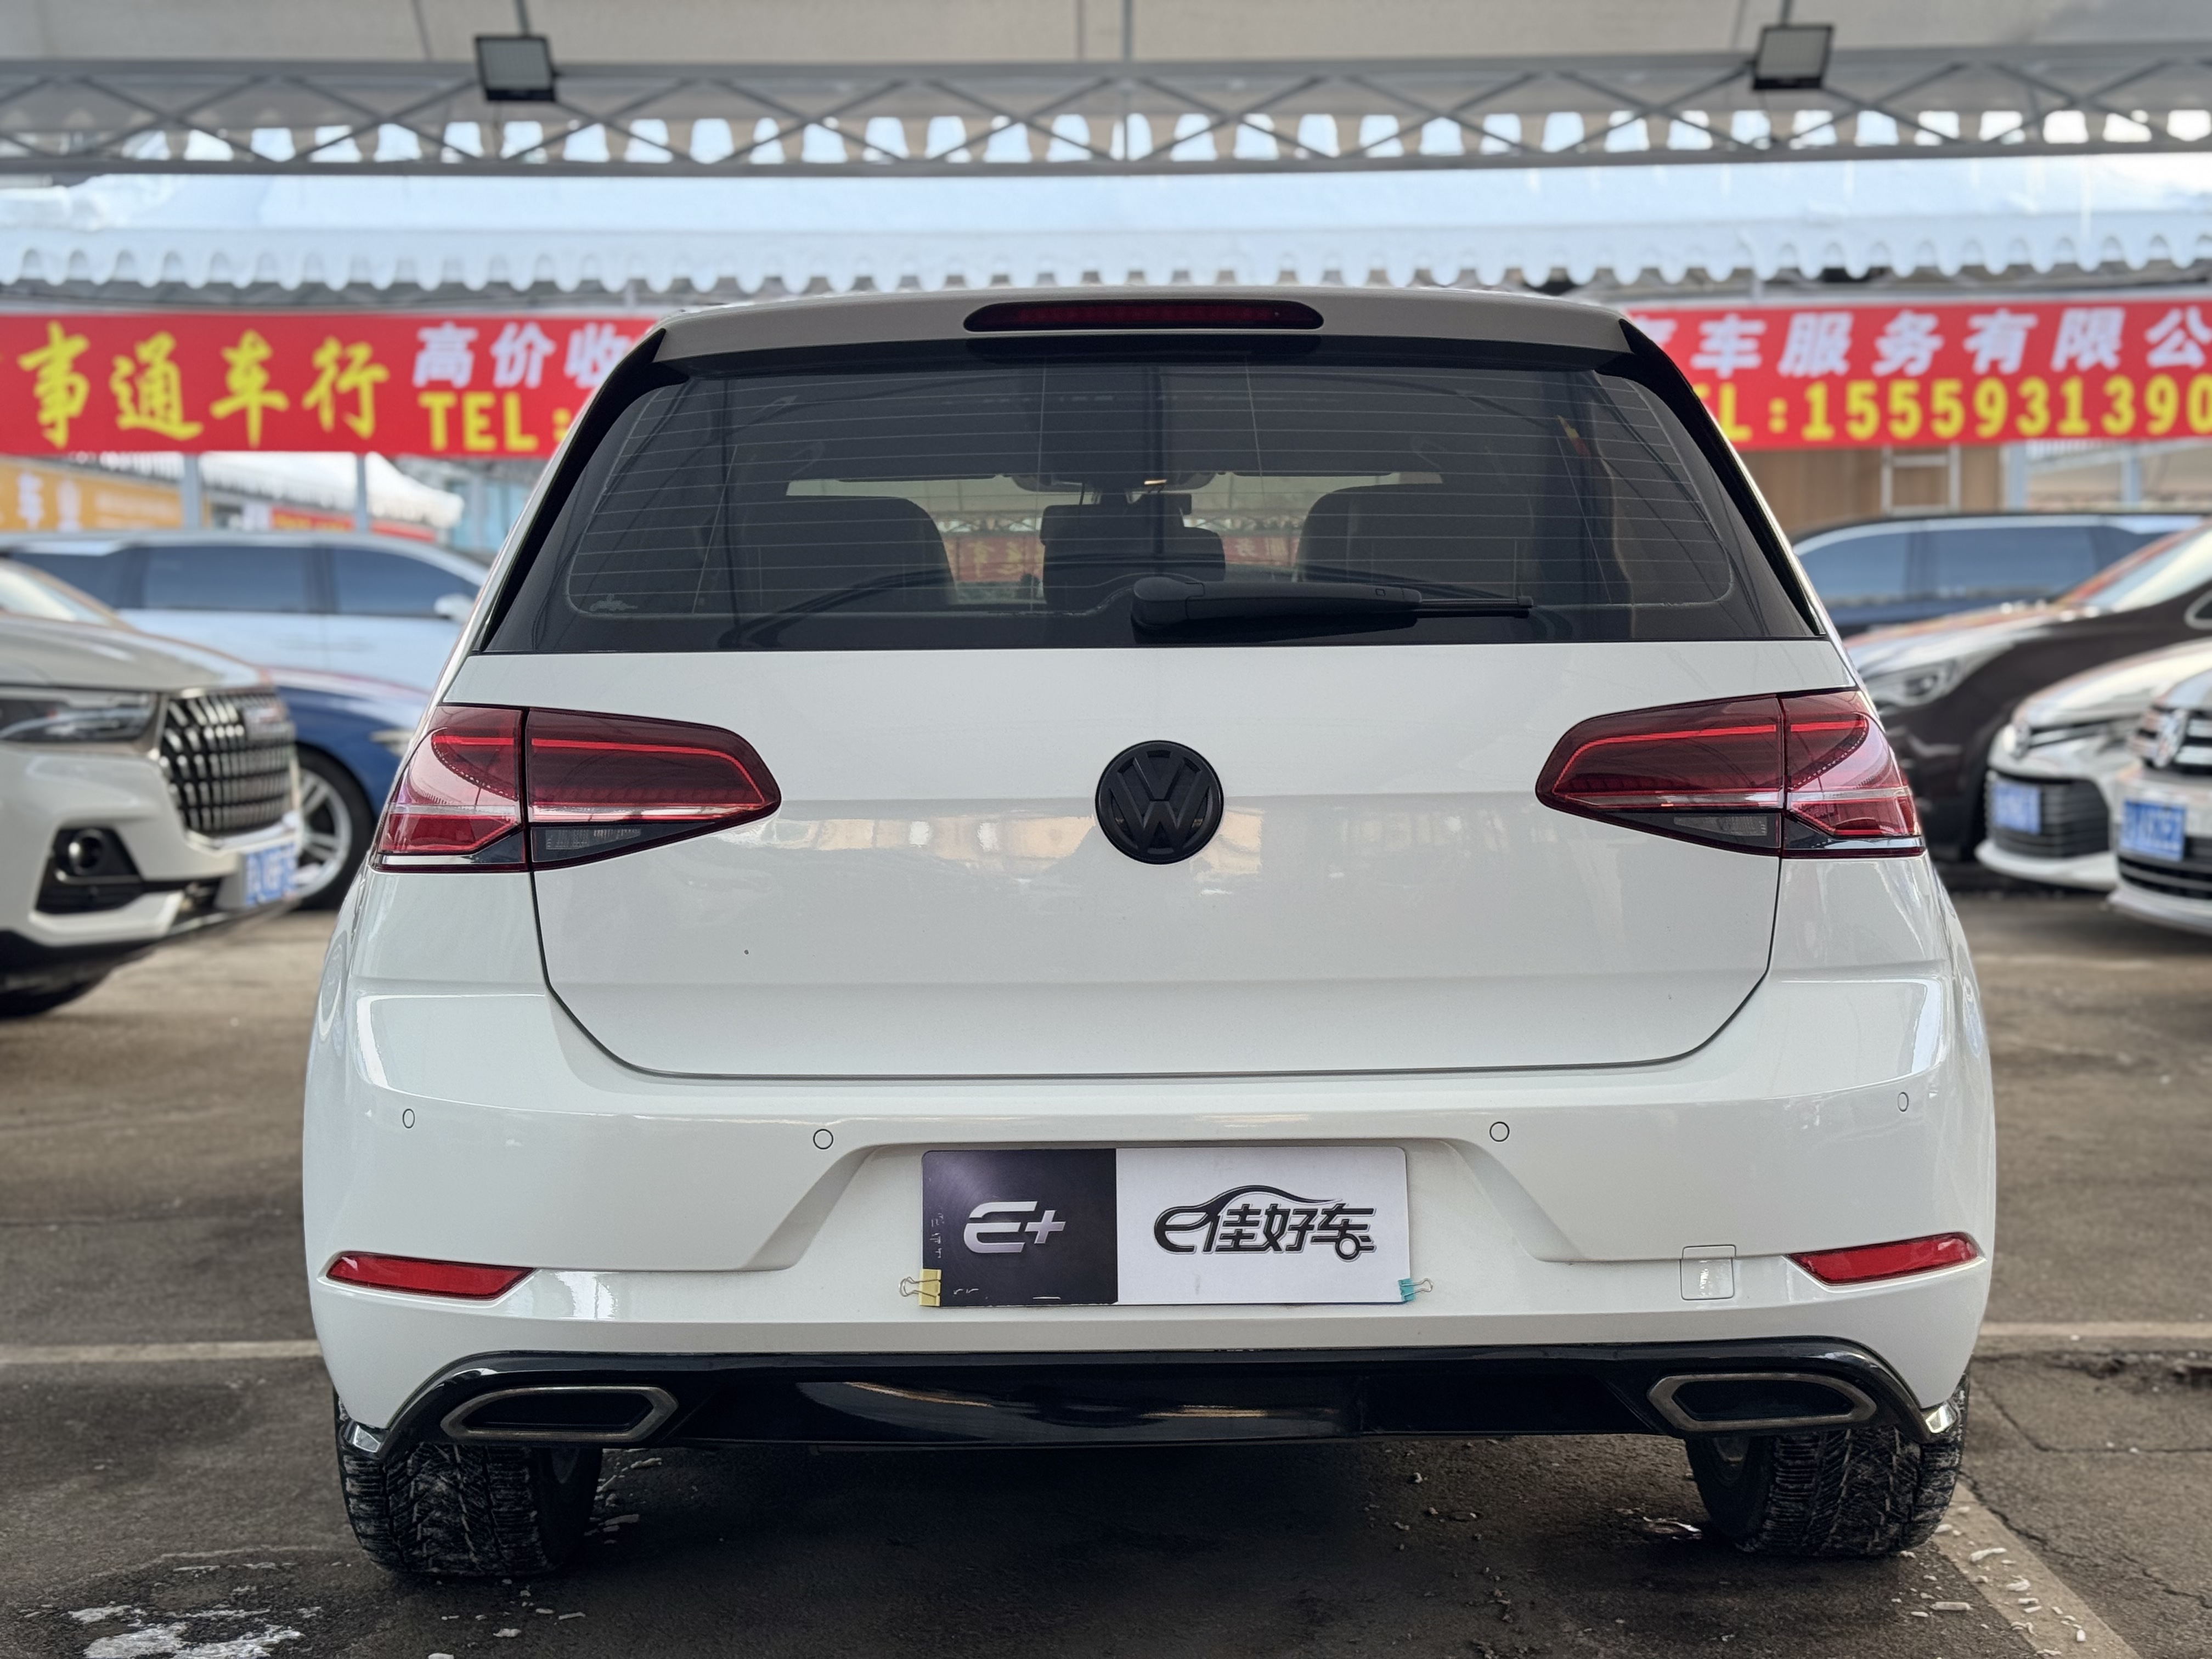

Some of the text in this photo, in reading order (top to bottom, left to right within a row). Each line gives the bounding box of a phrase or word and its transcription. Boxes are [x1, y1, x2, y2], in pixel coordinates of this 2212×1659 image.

[413, 321, 629, 388] 高价收
[418, 391, 571, 451] TEL:
[1693, 374, 2212, 442] L:1555931390
